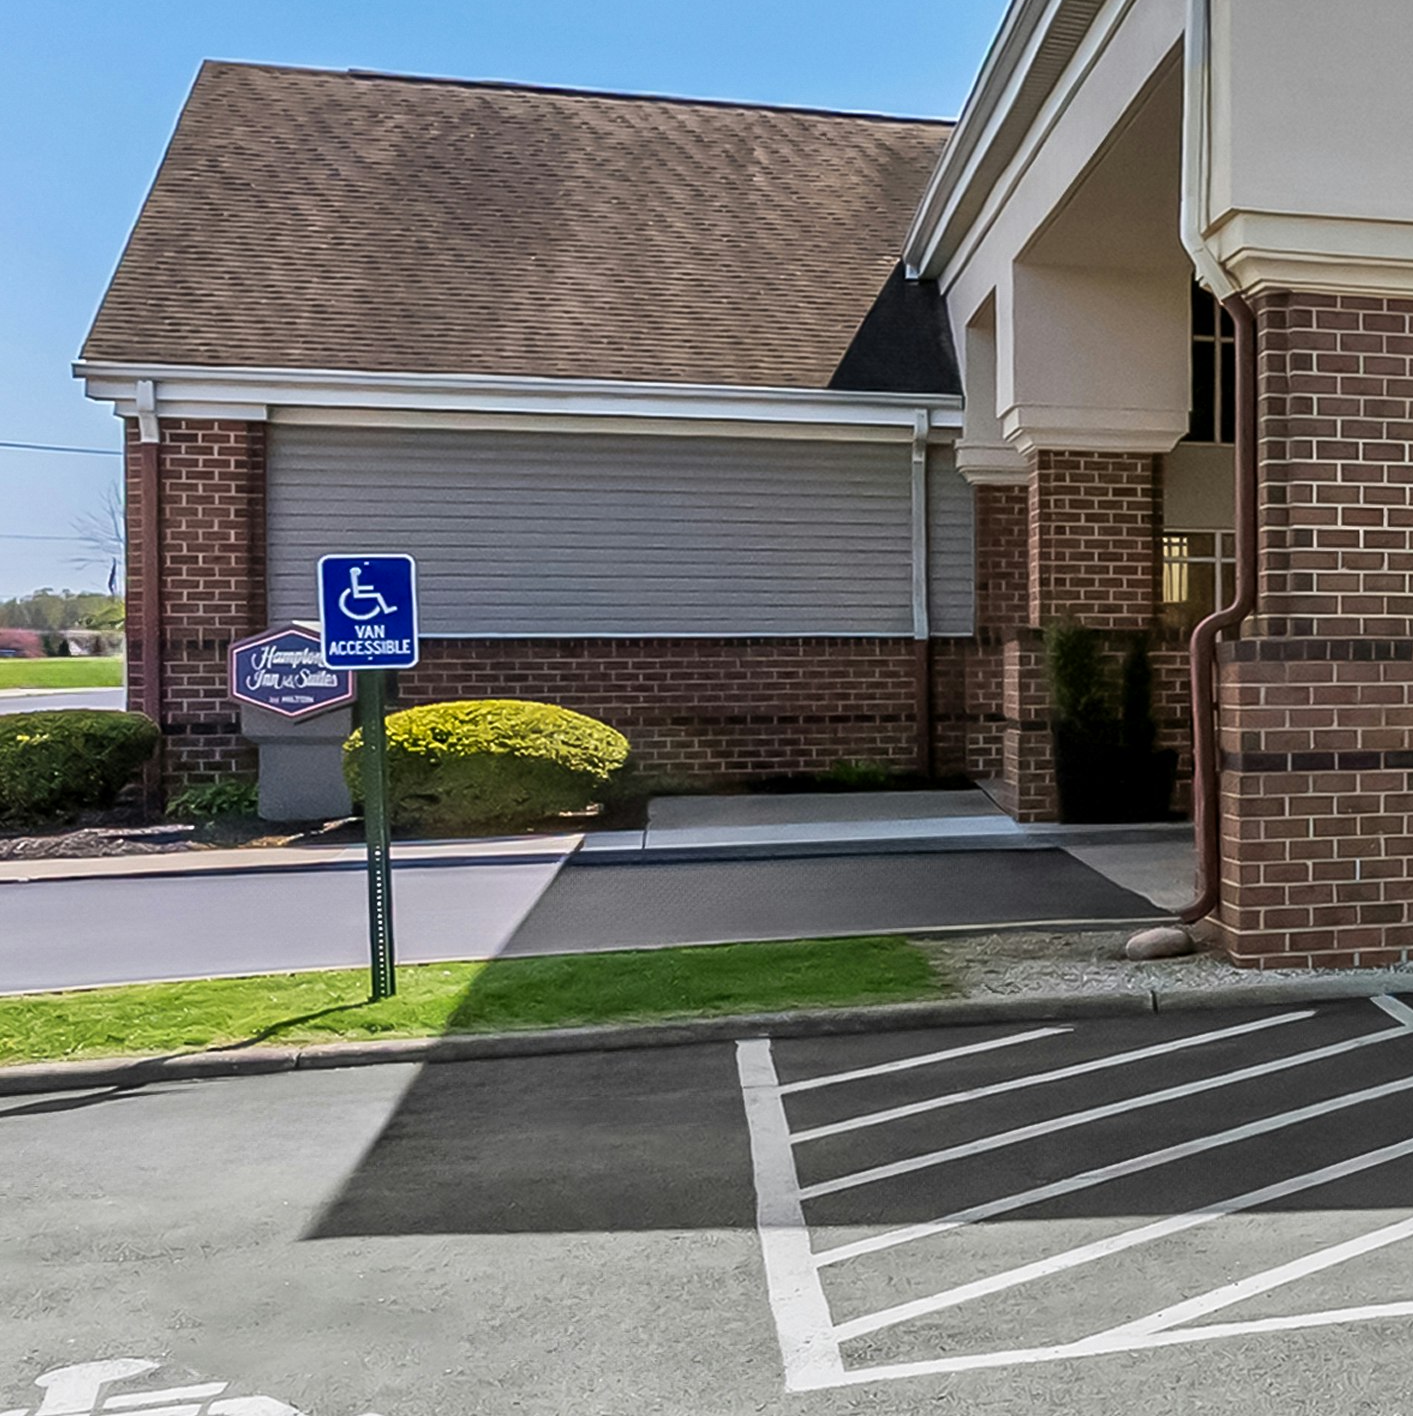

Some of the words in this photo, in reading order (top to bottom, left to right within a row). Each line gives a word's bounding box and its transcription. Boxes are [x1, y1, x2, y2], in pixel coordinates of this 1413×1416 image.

[354, 625, 385, 638] VAN
[329, 639, 411, 655] ACCESSIBLE
[246, 669, 283, 690] Inn
[294, 668, 338, 688] Suites
